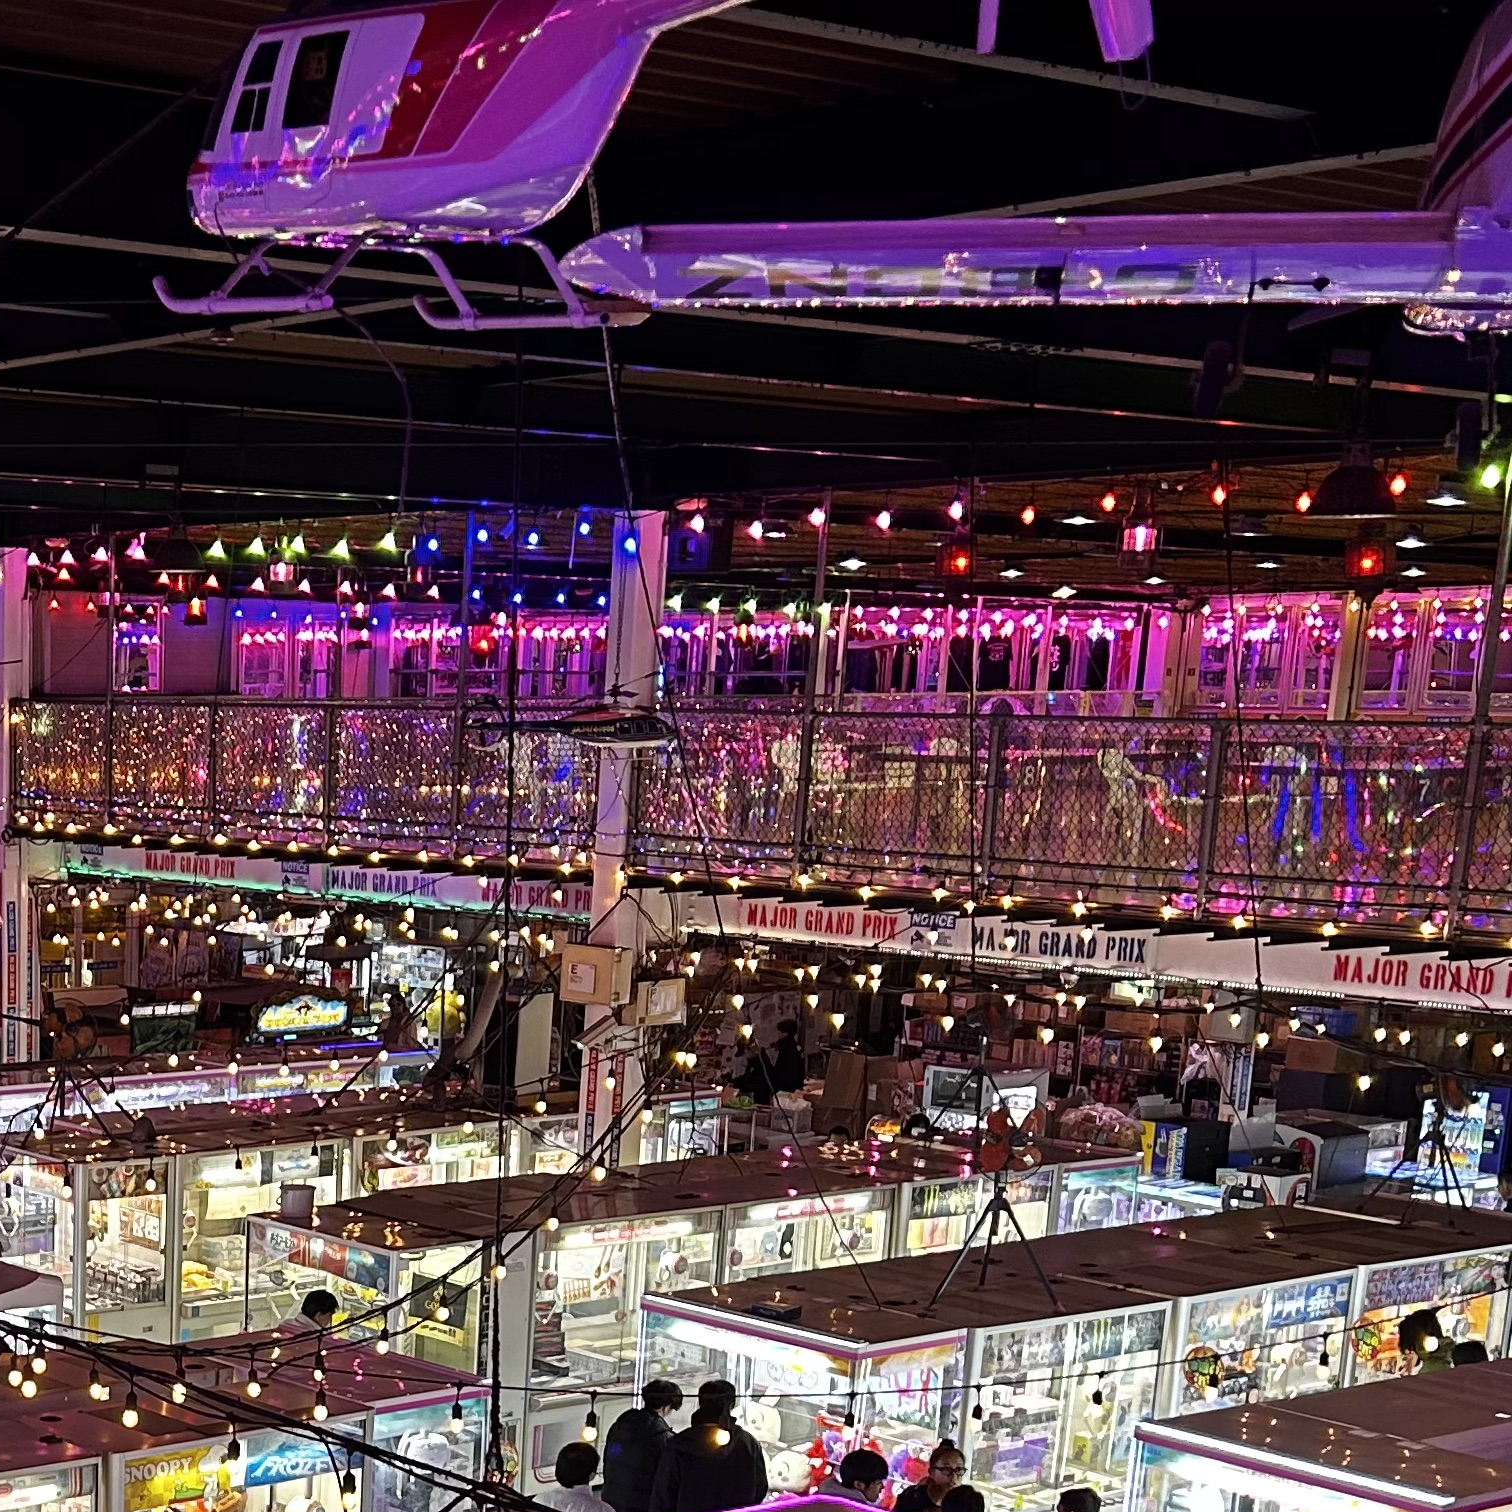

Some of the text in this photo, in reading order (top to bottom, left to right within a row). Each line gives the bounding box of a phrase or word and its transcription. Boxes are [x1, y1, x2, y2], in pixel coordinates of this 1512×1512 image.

[145, 852, 236, 879] MAJOR GRAND PRIX
[372, 873, 408, 894] GRAND
[747, 903, 898, 940] MAJOR GRAND PRIX
[1105, 936, 1146, 963] PRIX
[1333, 954, 1408, 986] MAJOR
[1419, 963, 1494, 995] GRAND
[124, 1457, 192, 1484] SNOOPY
